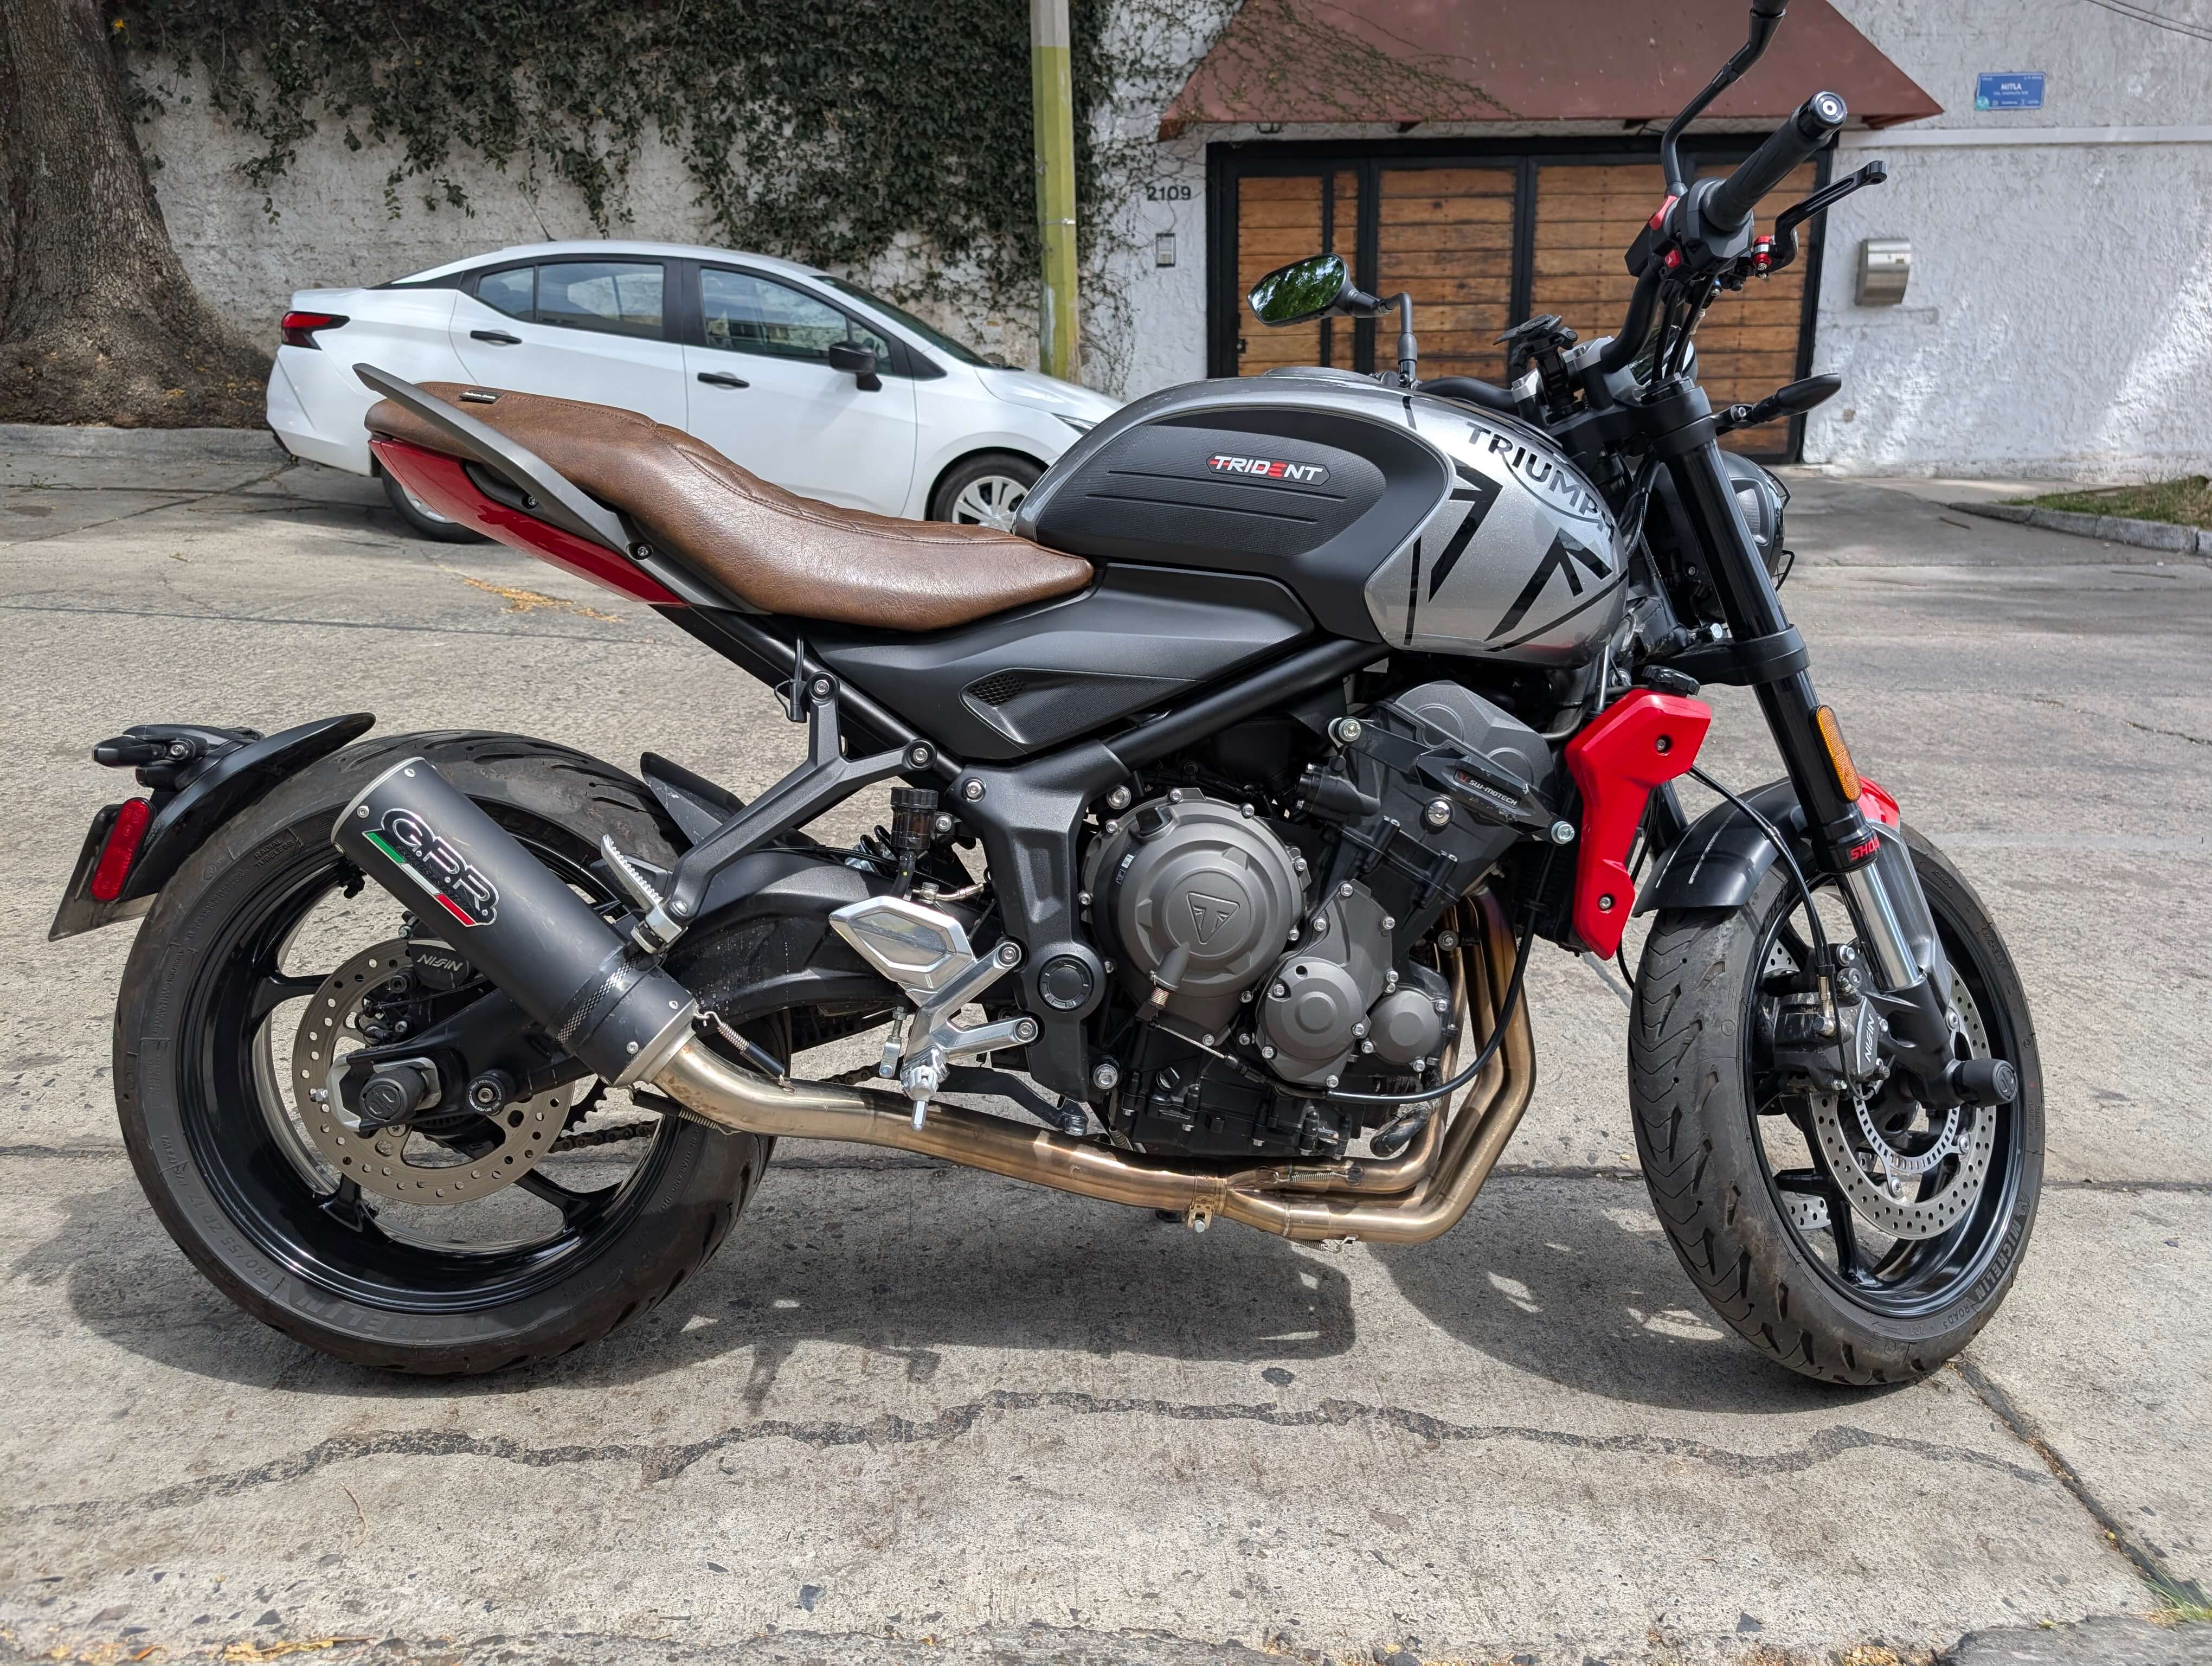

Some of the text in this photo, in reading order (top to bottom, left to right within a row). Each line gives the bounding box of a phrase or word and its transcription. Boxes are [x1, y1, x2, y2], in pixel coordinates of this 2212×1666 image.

[2001, 82, 2022, 91] MITLA
[1147, 186, 1191, 201] 2109
[1210, 456, 1323, 481] TRIDENT
[1466, 421, 1615, 543] TRIUMPH
[1469, 779, 1517, 806] SW-MOTECH
[416, 954, 464, 971] NISSIN
[1864, 1013, 1874, 1063] NISSIN
[203, 1214, 226, 1234] ZR
[220, 1236, 274, 1281] 180/55
[1975, 1219, 2022, 1300] MICHELIN
[296, 1295, 488, 1338] MICHELIN
